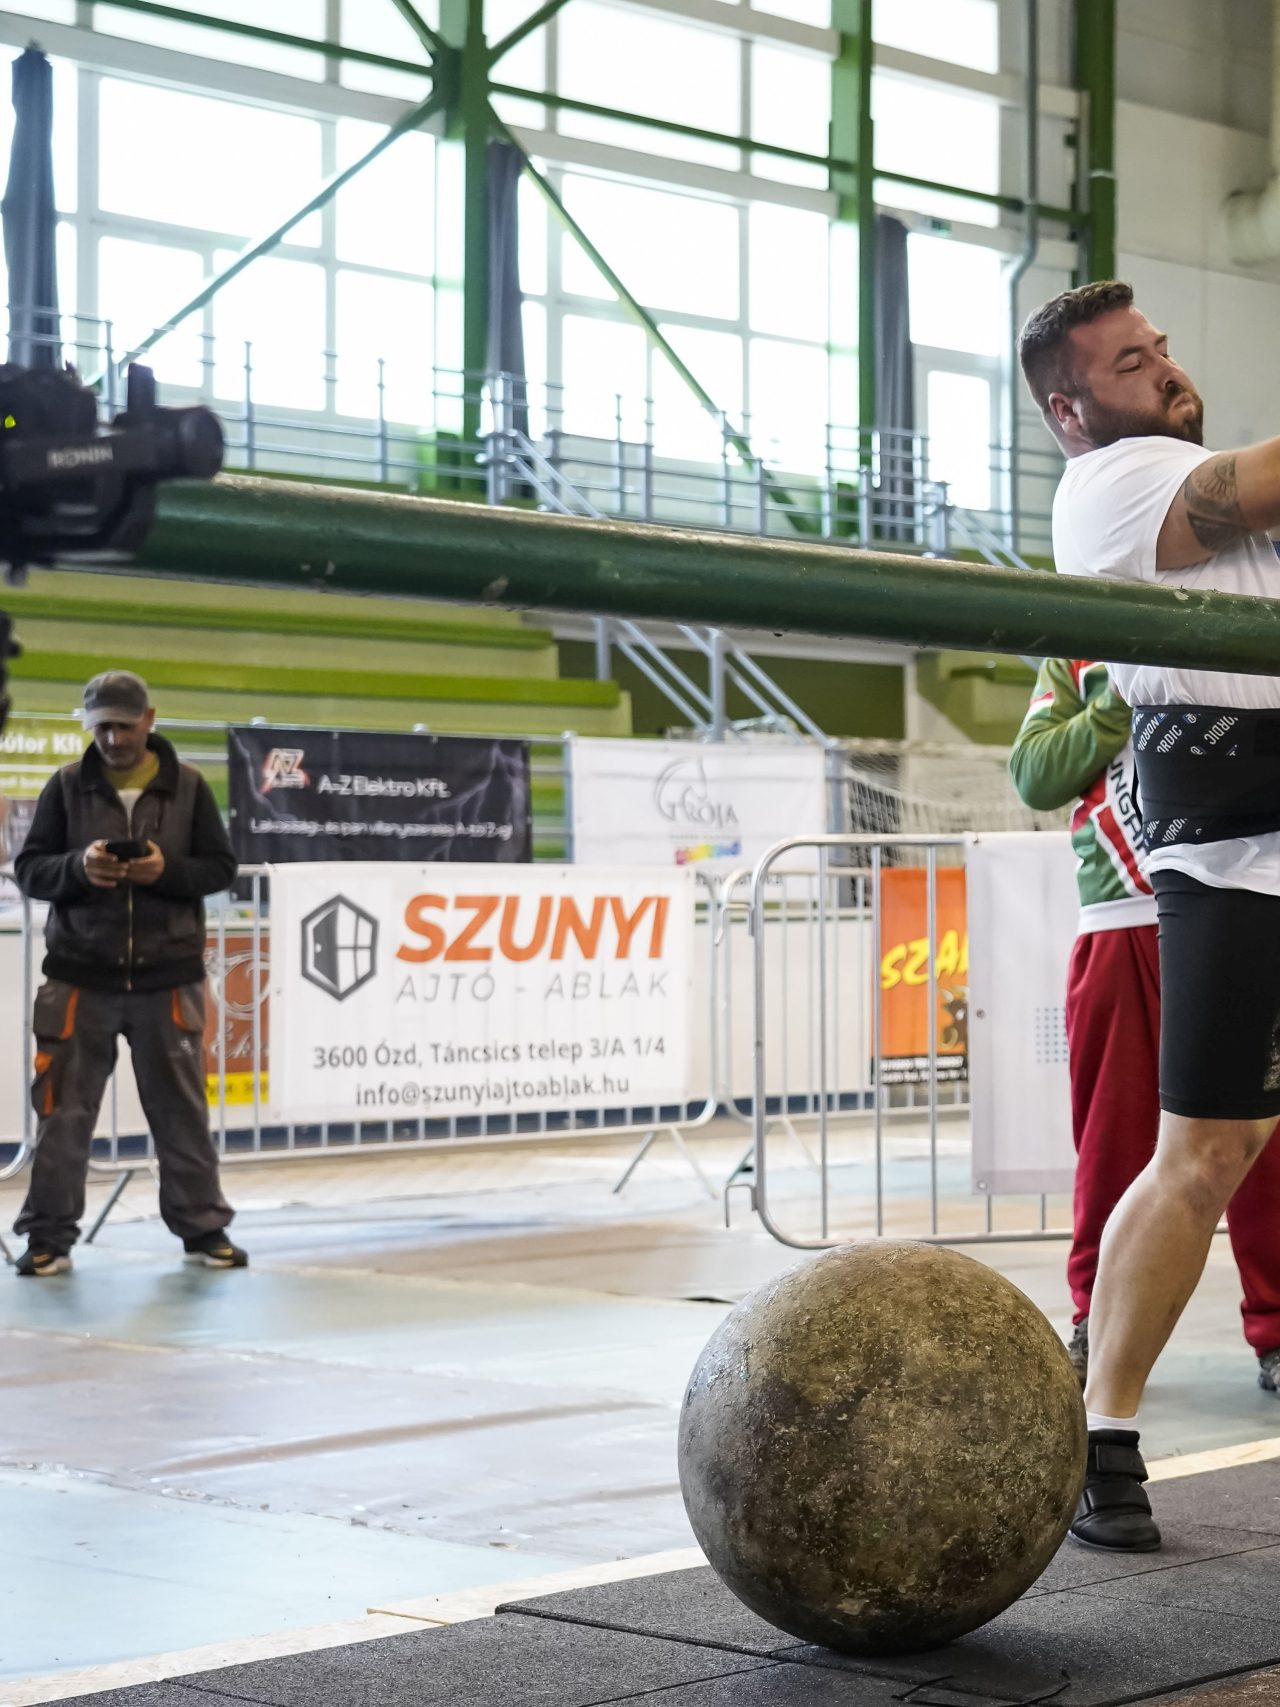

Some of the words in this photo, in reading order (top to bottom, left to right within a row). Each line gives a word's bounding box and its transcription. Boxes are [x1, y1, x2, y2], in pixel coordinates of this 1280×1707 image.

[47, 445, 114, 469] RONIN
[395, 893, 672, 964] SZUNYI
[395, 966, 496, 1004] AJTÓ
[544, 970, 672, 1001] ABLAK
[312, 1045, 368, 1069] 3600
[374, 1039, 424, 1068] Ózd,
[430, 1041, 521, 1065] Táncsics
[528, 1041, 583, 1065] telep
[588, 1037, 624, 1058] 3/A
[633, 1036, 666, 1057] 1/4
[355, 1073, 631, 1107] info@szunyiajtoablak.hu
